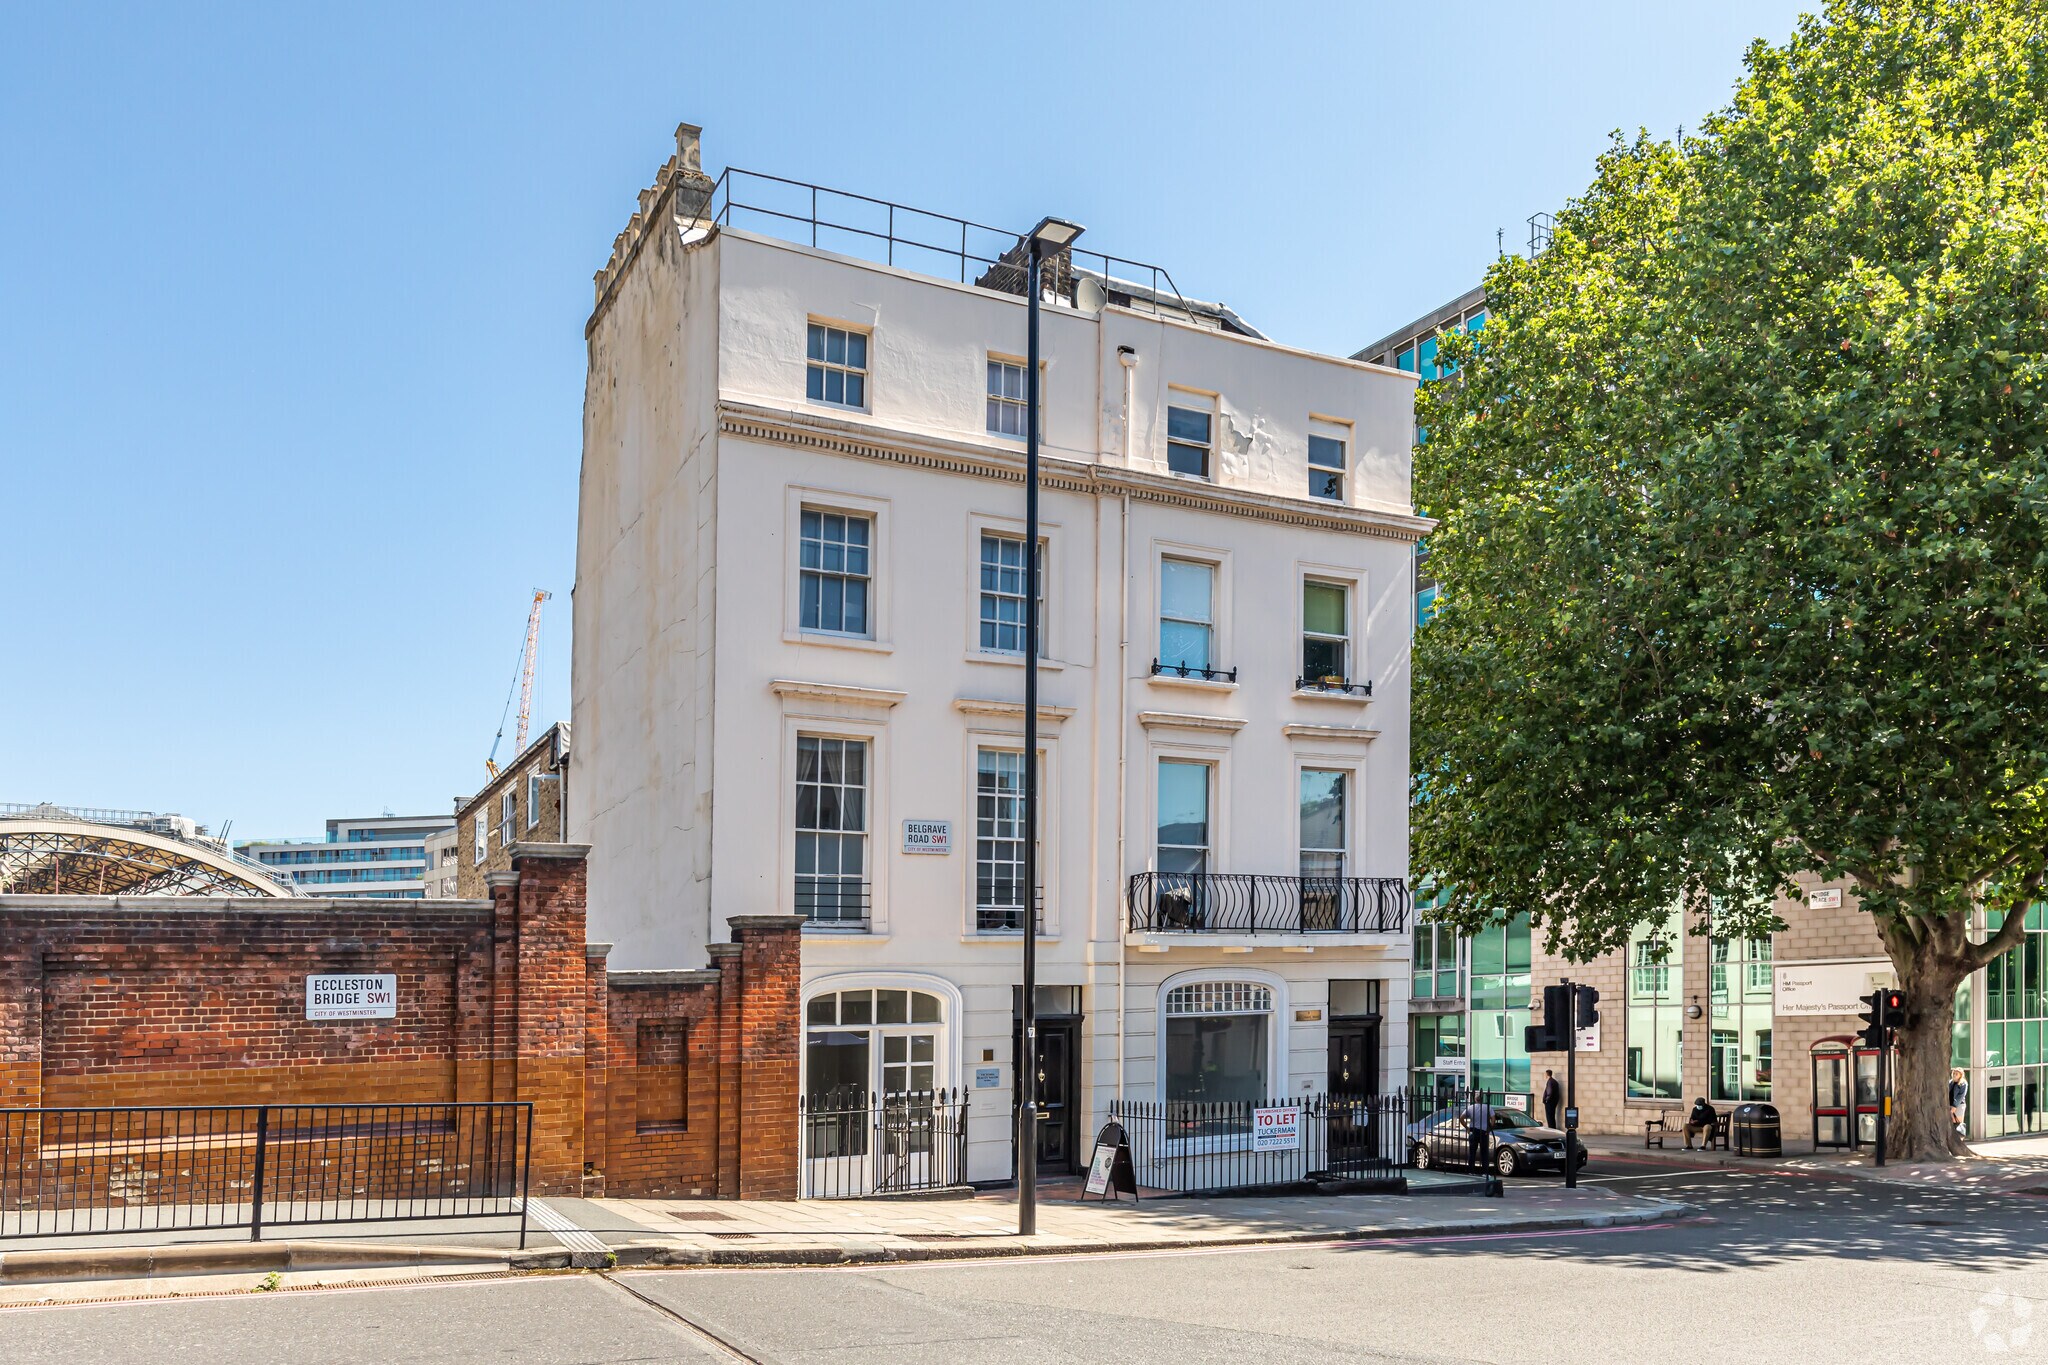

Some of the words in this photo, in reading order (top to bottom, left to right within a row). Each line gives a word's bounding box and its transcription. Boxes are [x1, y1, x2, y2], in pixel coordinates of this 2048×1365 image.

[908, 824, 947, 833] BELGRAVE
[908, 834, 929, 843] ROAD
[932, 835, 947, 844] SW1
[314, 979, 383, 991] ECCLESTON
[314, 993, 360, 1005] BRIDGE
[367, 992, 390, 1004] SW1
[1795, 1003, 1827, 1012] Majesty's
[1828, 1003, 1858, 1011] Passport
[1257, 1115, 1273, 1126] TO
[1276, 1113, 1296, 1125] LET
[1257, 1126, 1296, 1135] TUCKERMAN
